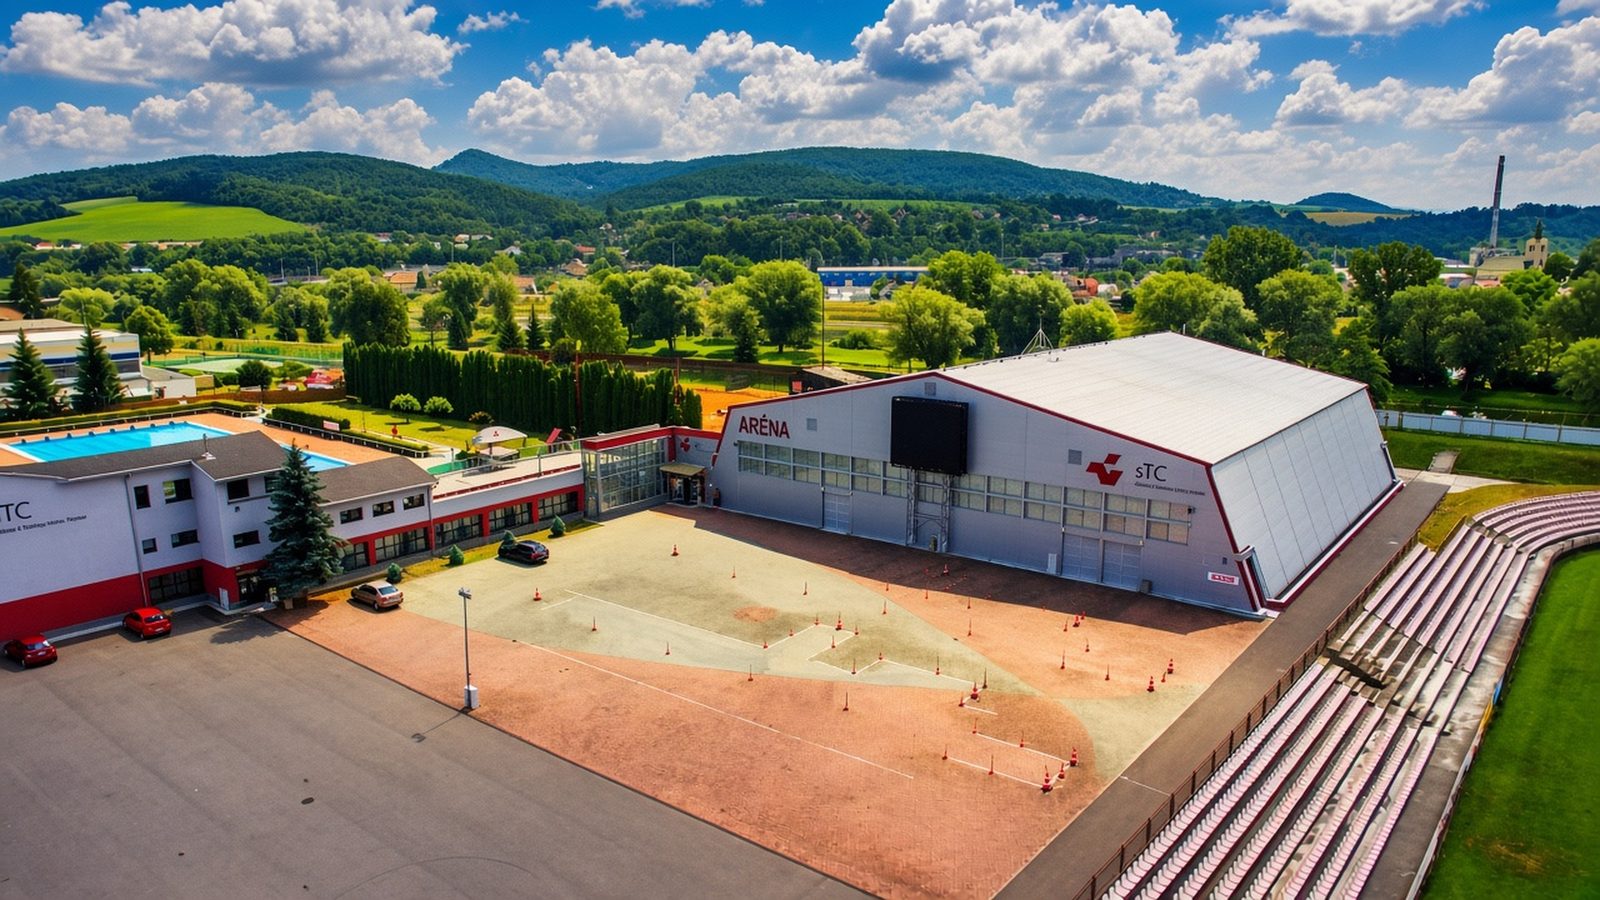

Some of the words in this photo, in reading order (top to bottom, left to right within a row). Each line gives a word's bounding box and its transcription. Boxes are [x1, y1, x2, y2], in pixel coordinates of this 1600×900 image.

[739, 414, 790, 439] ARÉNA
[1135, 463, 1168, 482] sTC
[0, 501, 32, 522] TC
